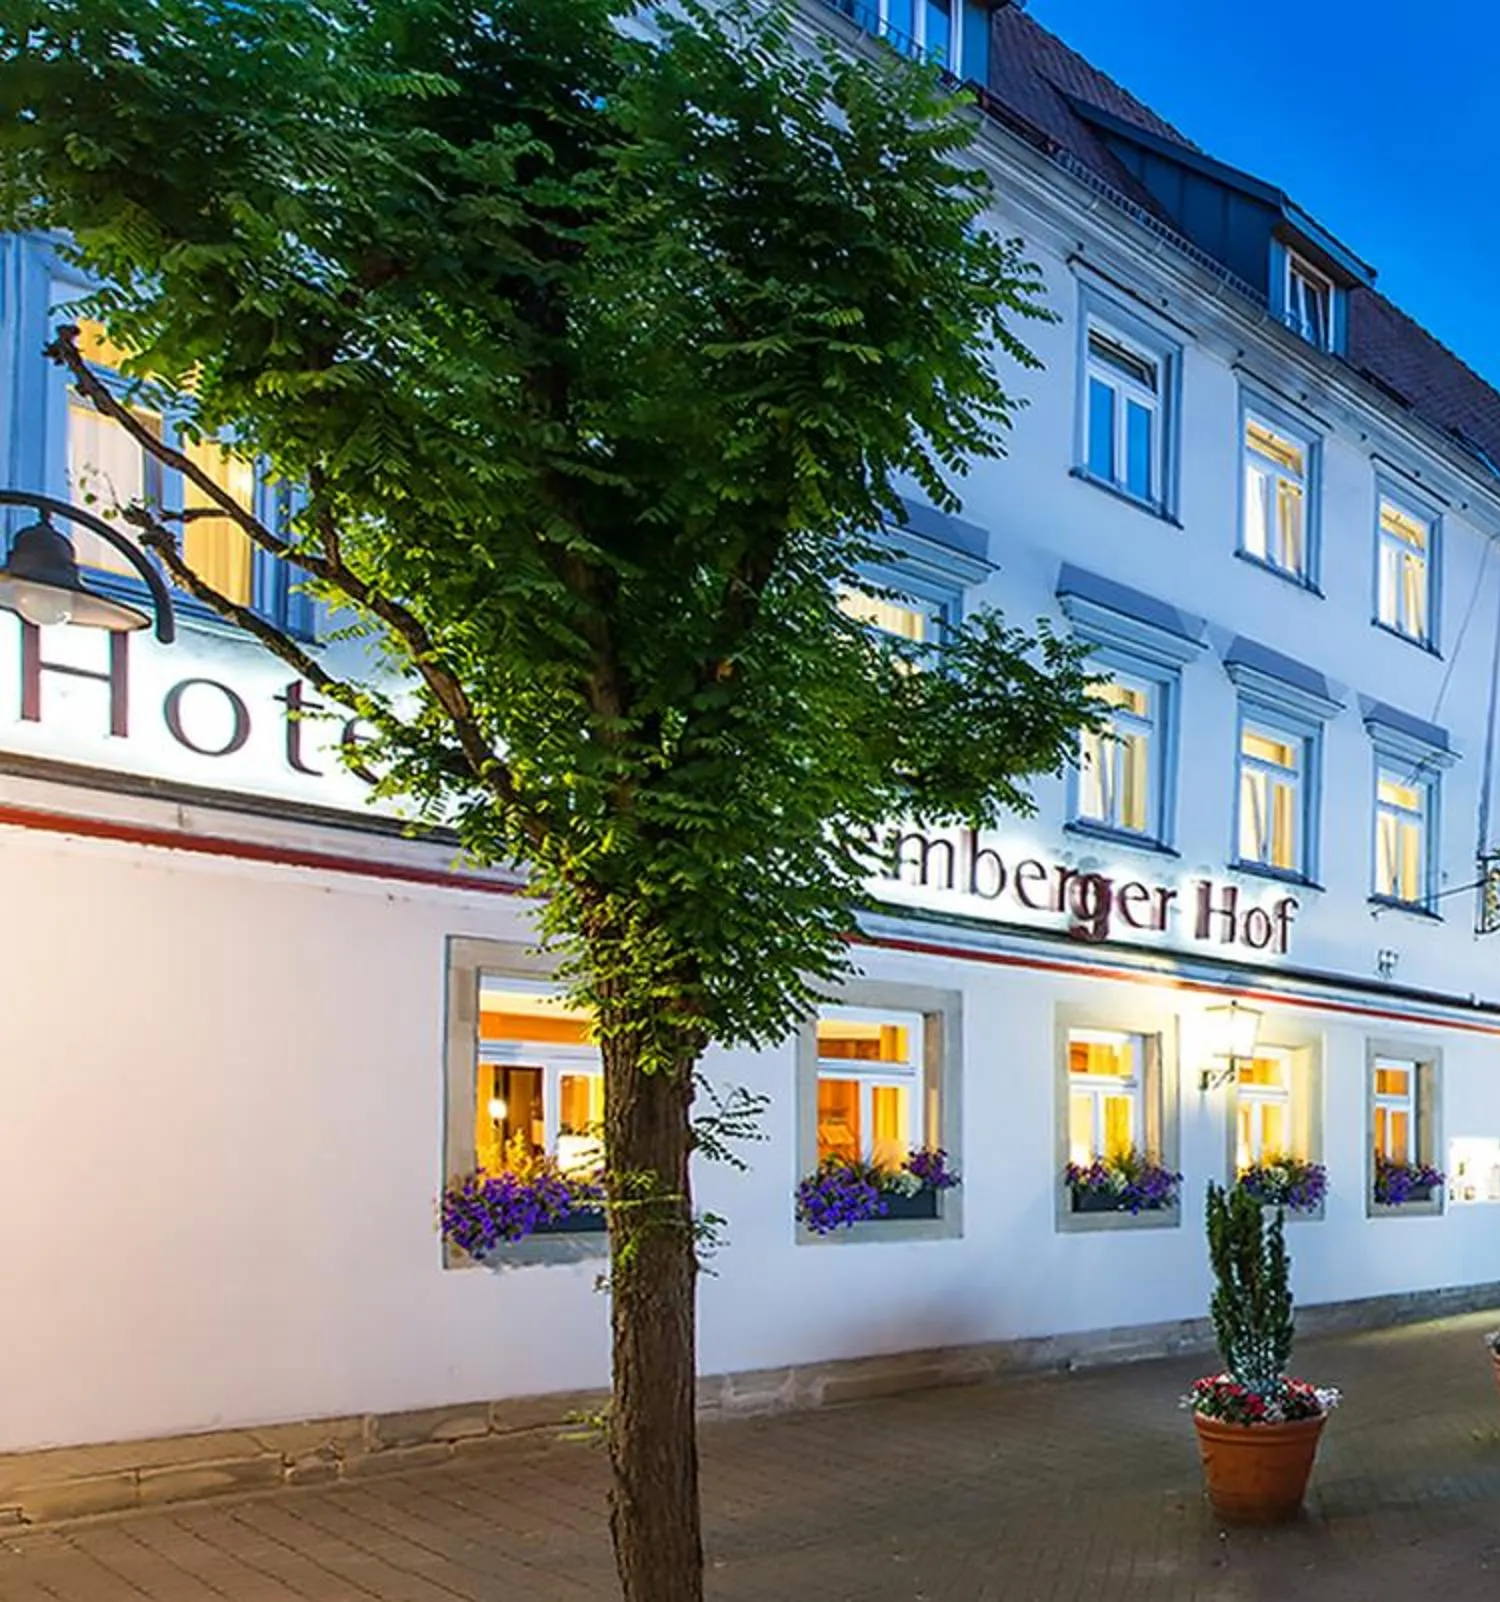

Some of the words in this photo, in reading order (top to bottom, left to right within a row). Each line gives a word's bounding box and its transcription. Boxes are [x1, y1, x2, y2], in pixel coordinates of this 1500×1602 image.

[20, 622, 390, 785] Hote
[886, 829, 1178, 942] mberger
[1192, 879, 1299, 954] Hof
